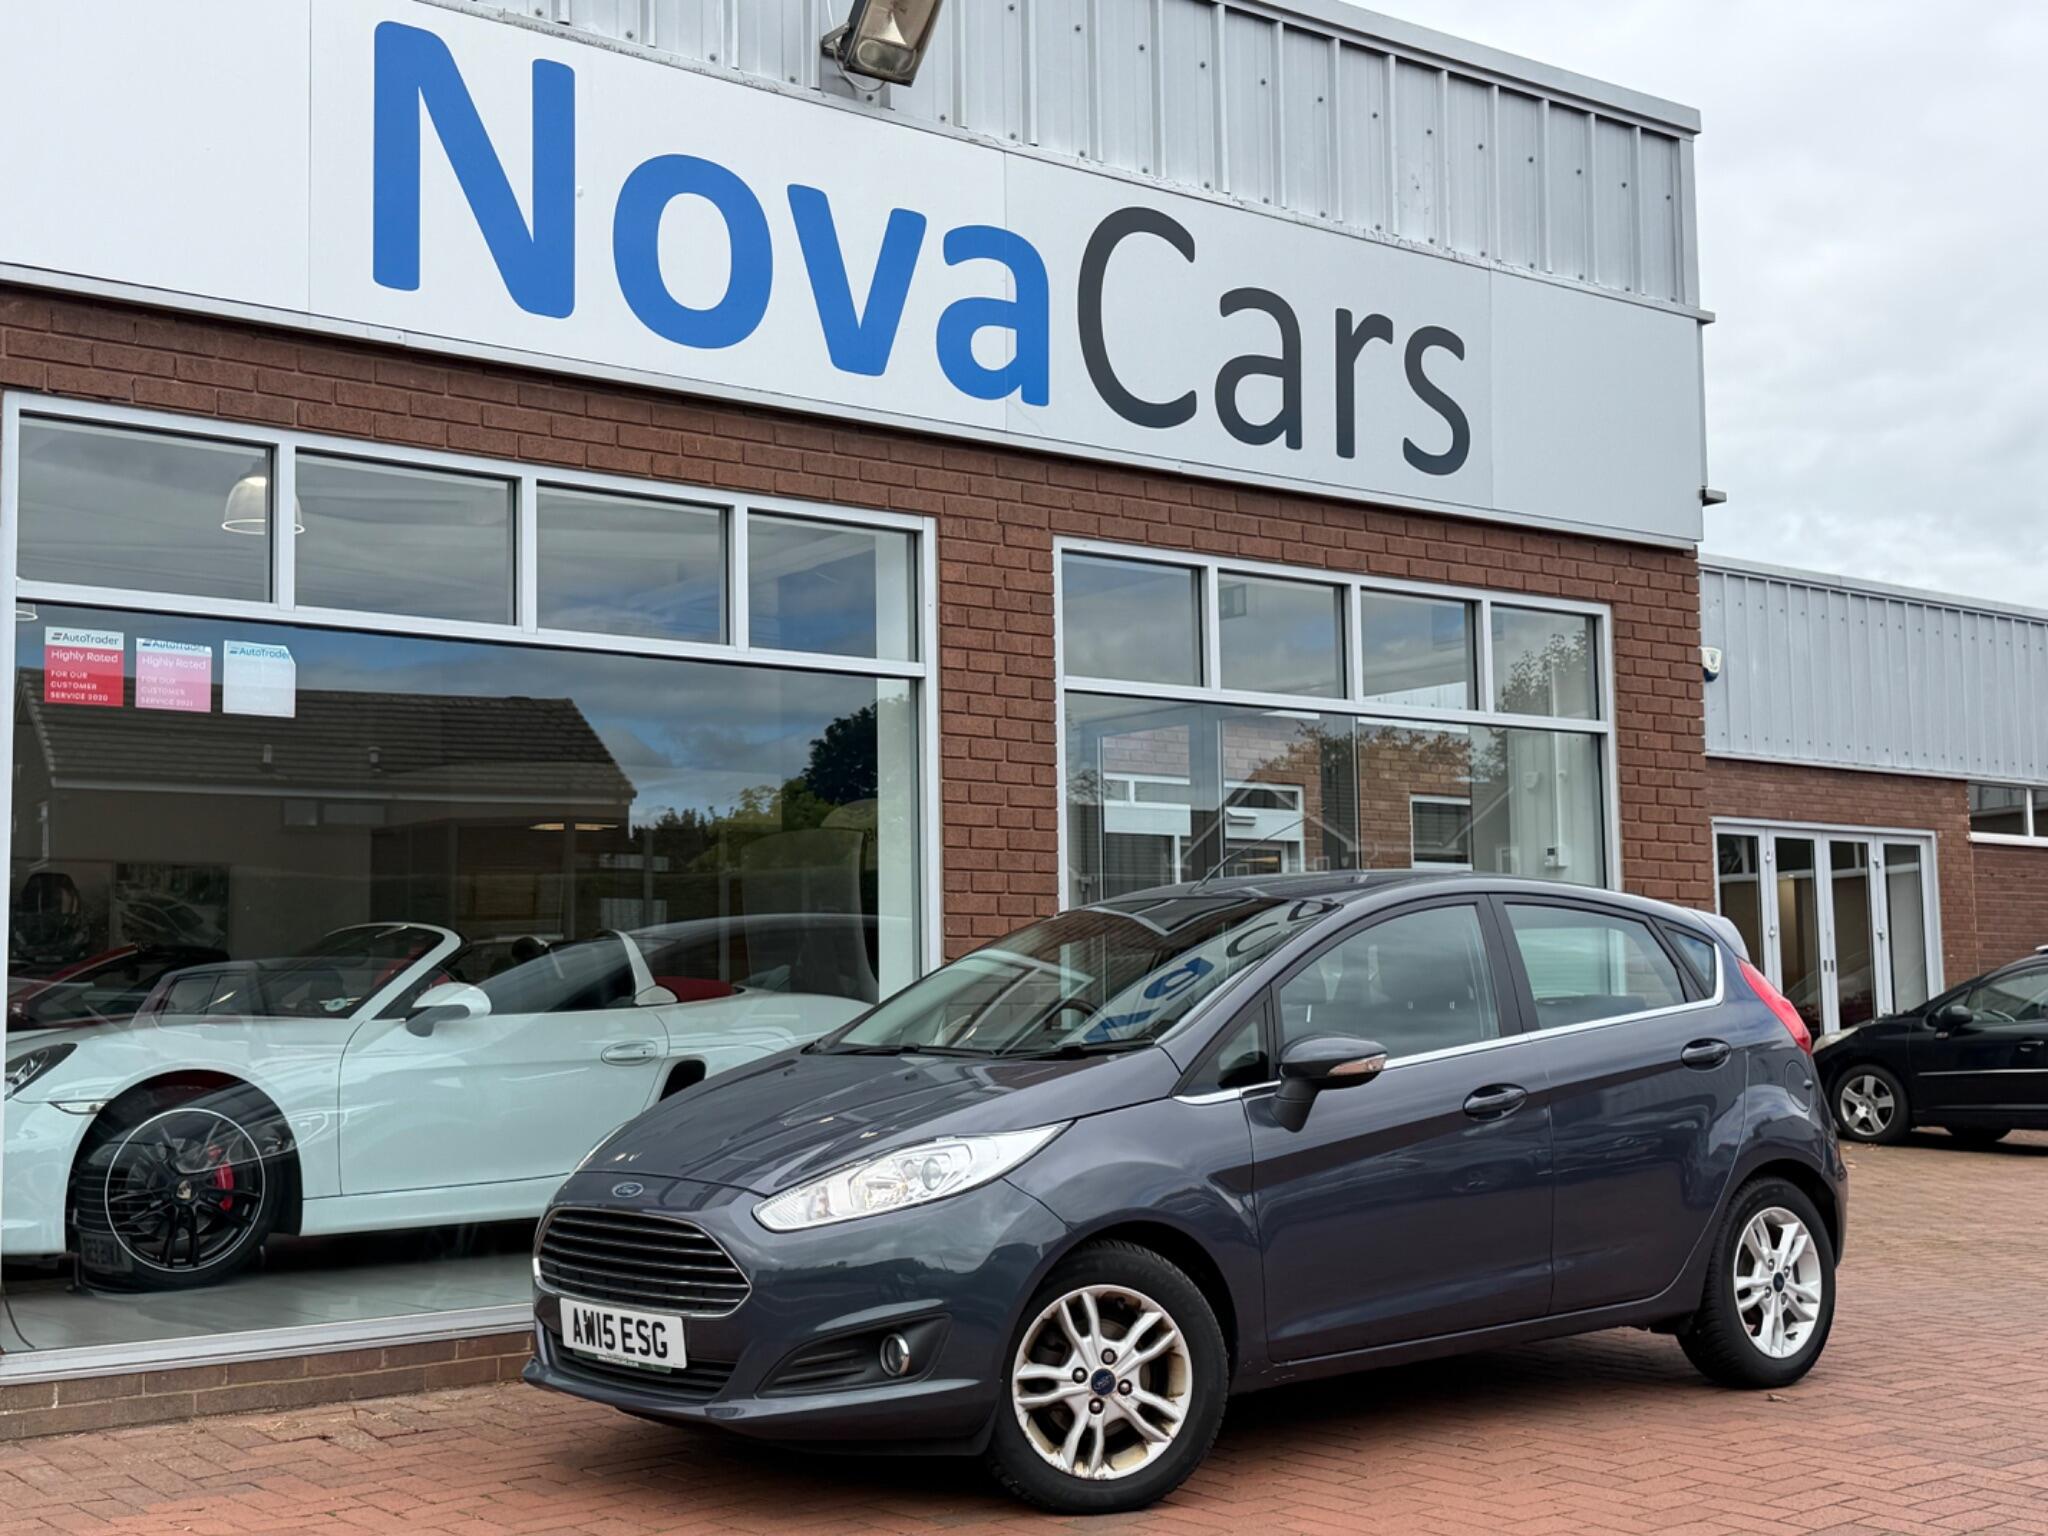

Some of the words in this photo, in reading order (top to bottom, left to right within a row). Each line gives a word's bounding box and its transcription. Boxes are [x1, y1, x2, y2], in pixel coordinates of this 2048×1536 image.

[62, 633, 119, 645] AutoTrader
[51, 649, 85, 663] Highly
[87, 652, 119, 663] Rated
[239, 647, 289, 659] AutoTrade
[142, 655, 175, 668] Highly
[175, 658, 206, 669] Rated
[50, 670, 69, 678] FOR
[69, 671, 88, 679] OUR
[50, 680, 97, 690] CUSTOMER
[50, 691, 85, 700] SERVICE
[573, 1307, 616, 1351] AW15
[620, 1316, 668, 1359] ESG
